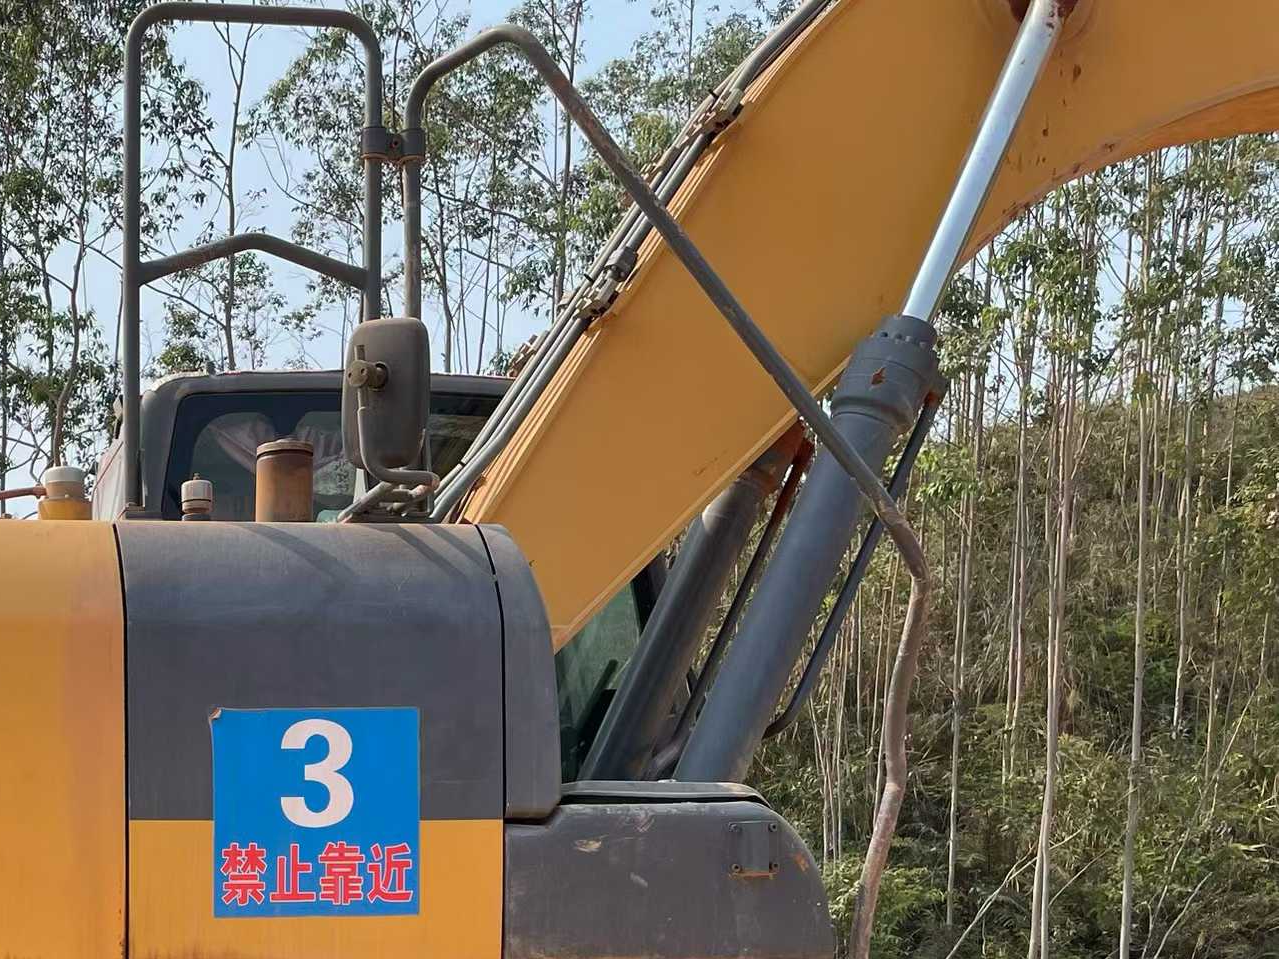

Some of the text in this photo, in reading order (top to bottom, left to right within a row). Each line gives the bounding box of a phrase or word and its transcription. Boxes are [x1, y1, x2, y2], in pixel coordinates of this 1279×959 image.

[280, 718, 354, 829] 3
[220, 840, 413, 906] 禁止靠近
